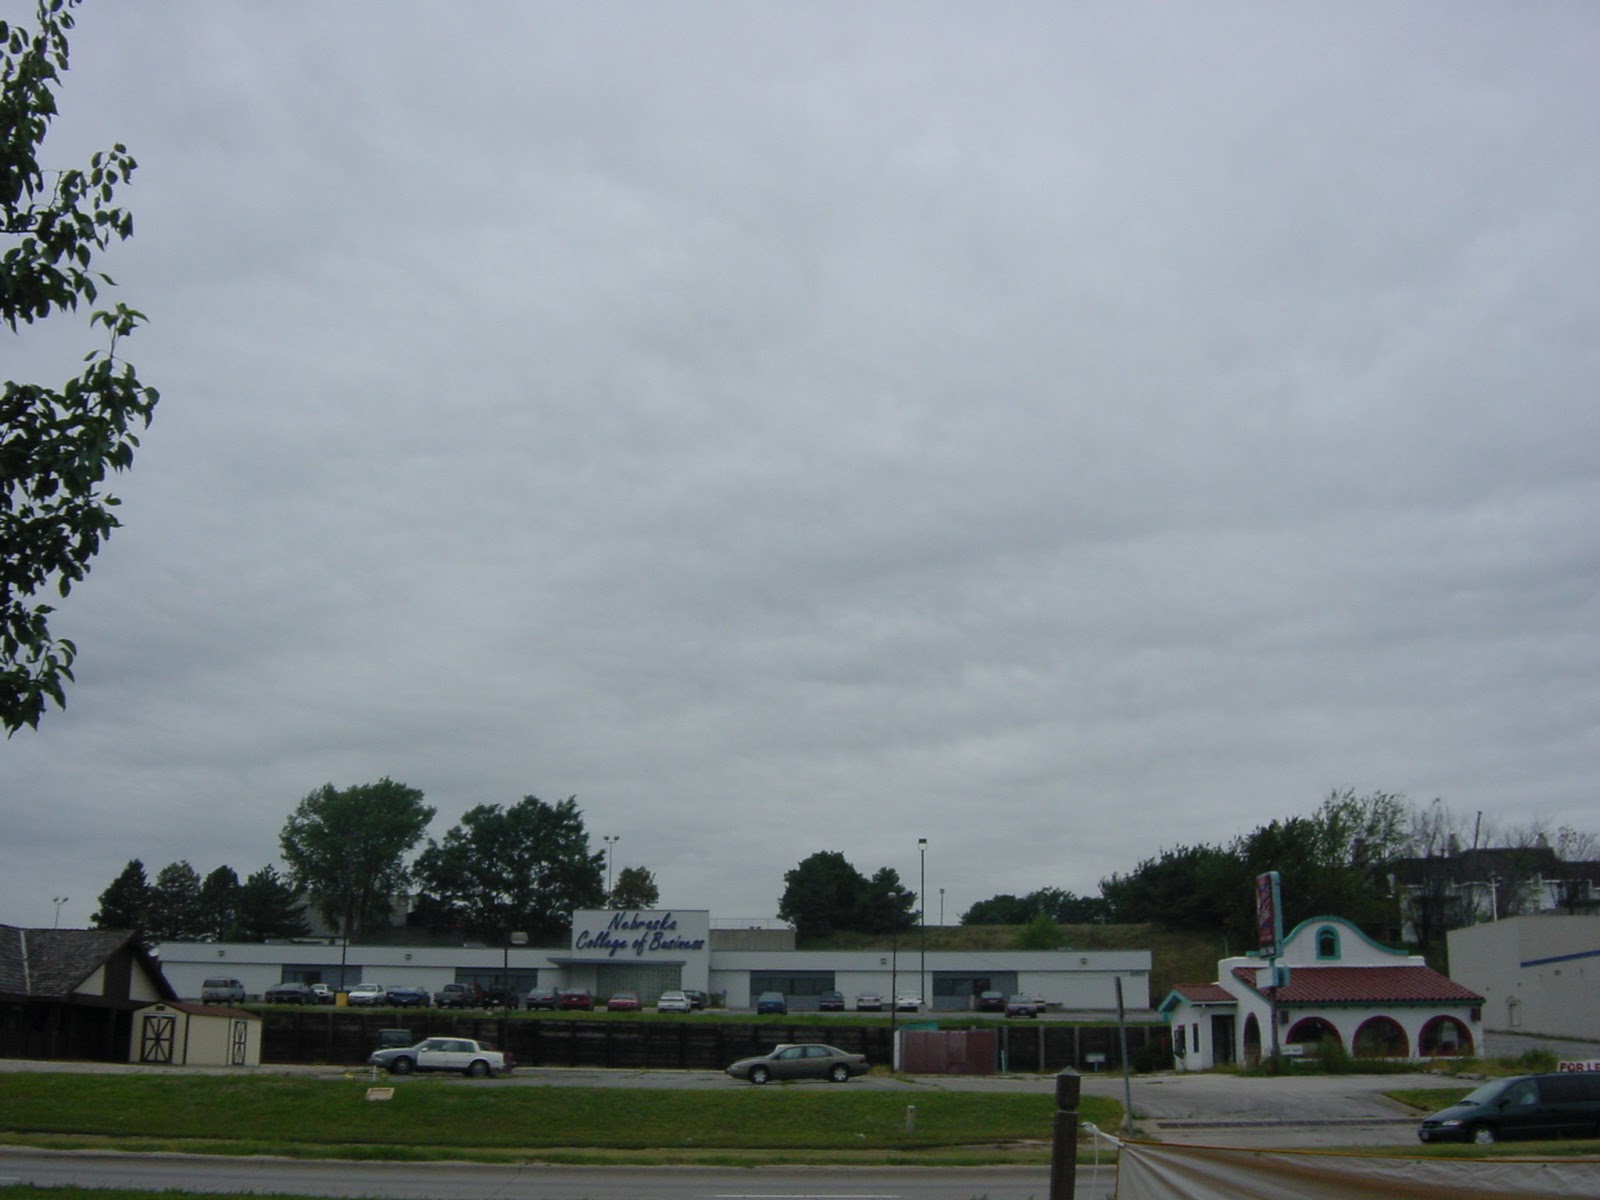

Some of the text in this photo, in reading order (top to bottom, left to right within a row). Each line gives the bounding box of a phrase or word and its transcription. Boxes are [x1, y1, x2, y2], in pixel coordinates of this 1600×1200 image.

[607, 911, 677, 930] Nebraska
[576, 929, 705, 957] College of Business
[1560, 1062, 1585, 1073] FOR
